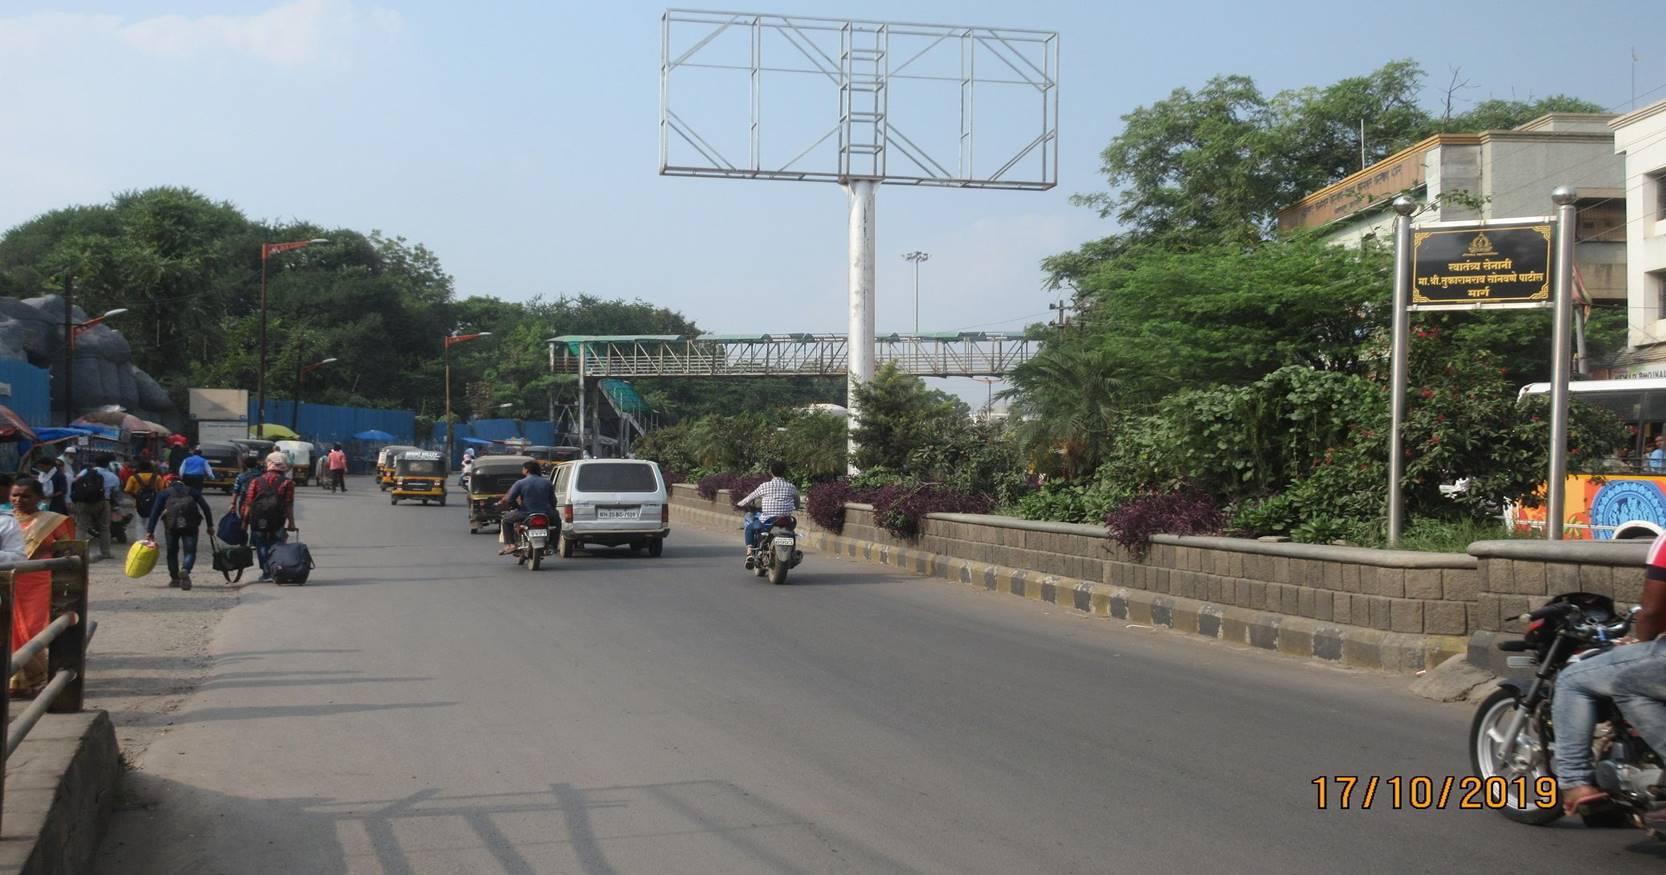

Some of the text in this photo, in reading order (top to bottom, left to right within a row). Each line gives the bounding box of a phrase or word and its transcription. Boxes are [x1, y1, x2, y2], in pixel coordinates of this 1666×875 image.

[1483, 258, 1512, 270] सेनानी
[1519, 270, 1544, 282] पाटील
[1468, 286, 1490, 297] मार्ग
